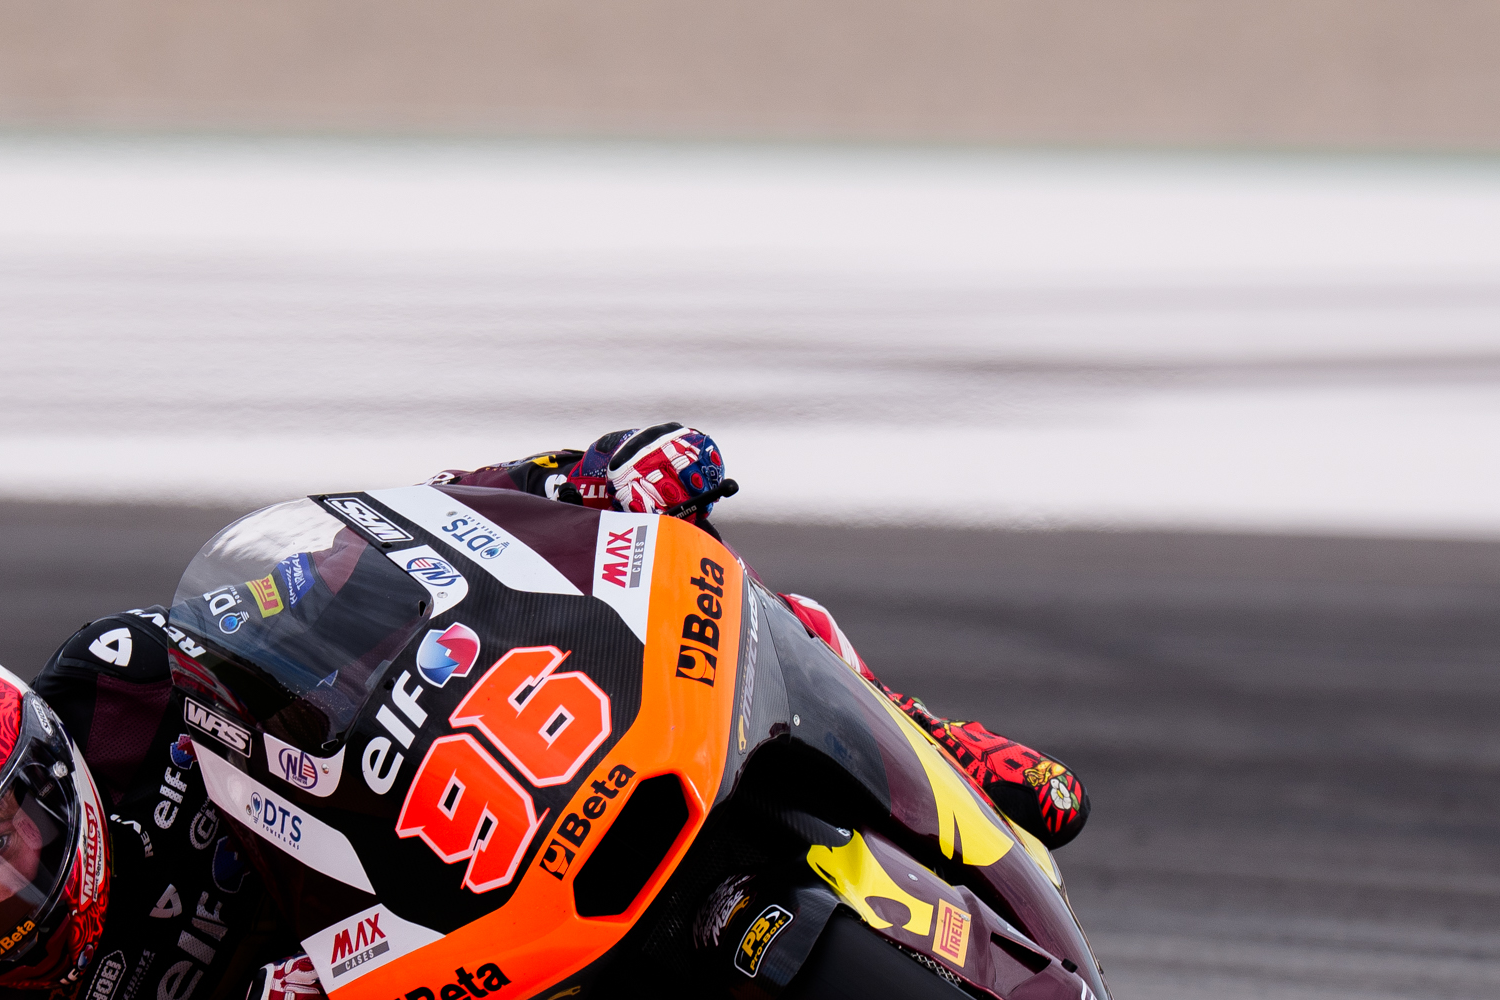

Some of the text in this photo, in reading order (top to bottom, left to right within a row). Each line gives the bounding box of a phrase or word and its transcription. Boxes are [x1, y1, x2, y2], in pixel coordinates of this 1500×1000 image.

[330, 500, 408, 540] WRS
[441, 518, 497, 552] DTS
[601, 527, 635, 588] MAX
[632, 541, 644, 573] CASES
[203, 587, 237, 616] DT
[682, 557, 724, 651] Beta
[187, 700, 250, 750] WRS
[361, 671, 430, 796] elf
[396, 646, 612, 894] 96
[153, 766, 188, 830] elf
[263, 798, 303, 843] DTS
[562, 763, 637, 851] Beta
[83, 807, 97, 896] Mutley
[0, 920, 35, 950] Beta
[331, 913, 387, 965] MAX
[742, 915, 771, 957] PB
[749, 919, 784, 972] Pro-Bolt
[939, 909, 969, 960] PIRELLI
[344, 949, 375, 972] CASES
